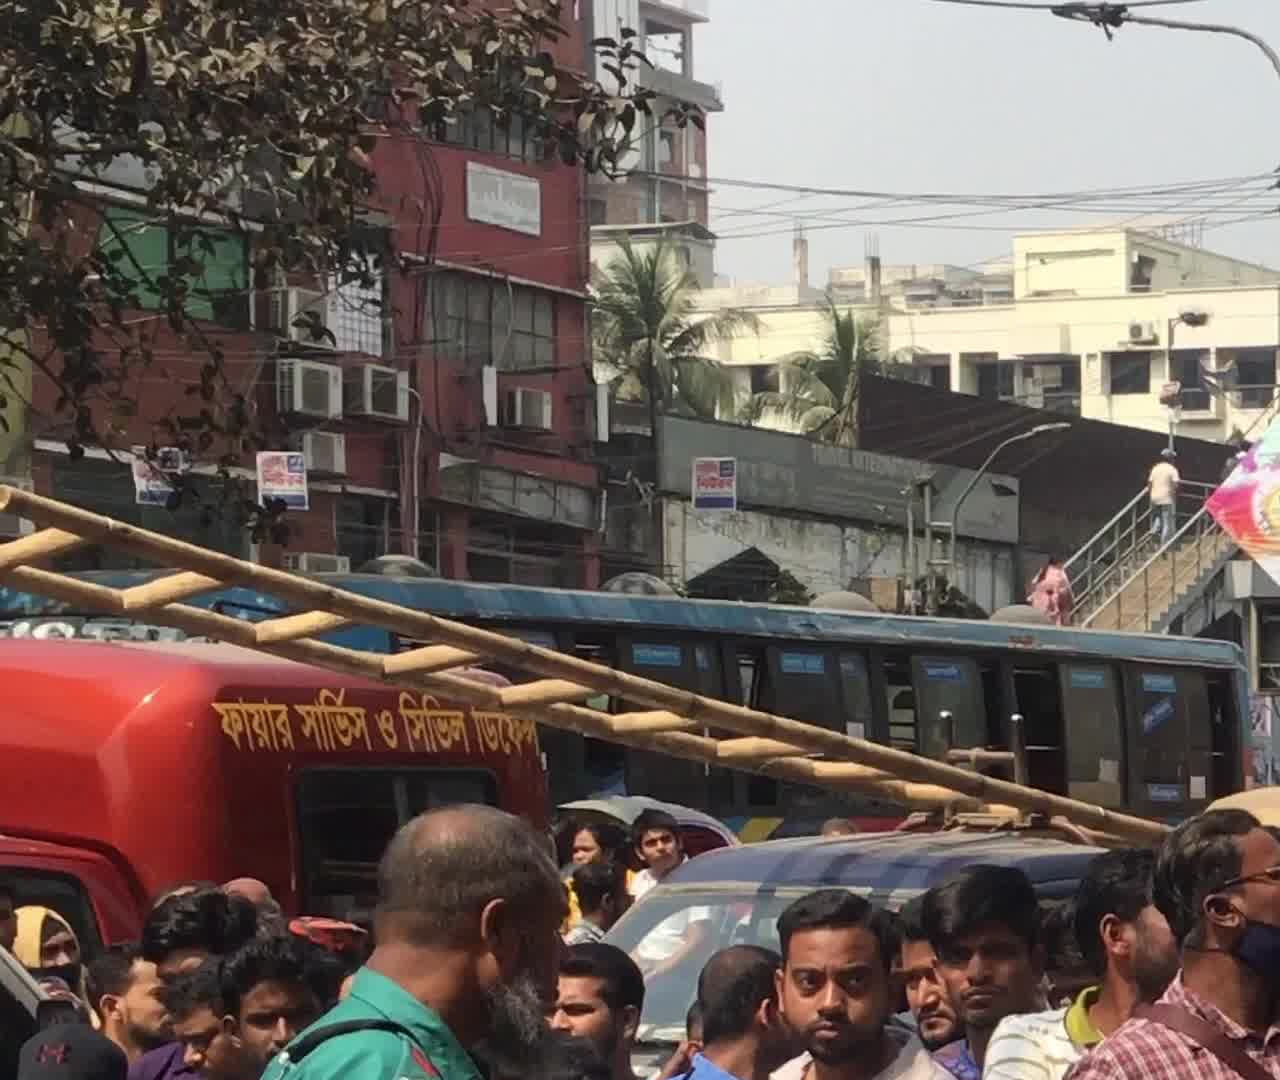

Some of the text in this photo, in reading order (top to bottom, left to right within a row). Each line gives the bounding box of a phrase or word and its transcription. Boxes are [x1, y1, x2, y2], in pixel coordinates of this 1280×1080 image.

[211, 697, 295, 751] ফায়ার
[294, 688, 372, 751] সার্ভিস
[376, 709, 398, 750] ও
[399, 692, 470, 752] সিভিল
